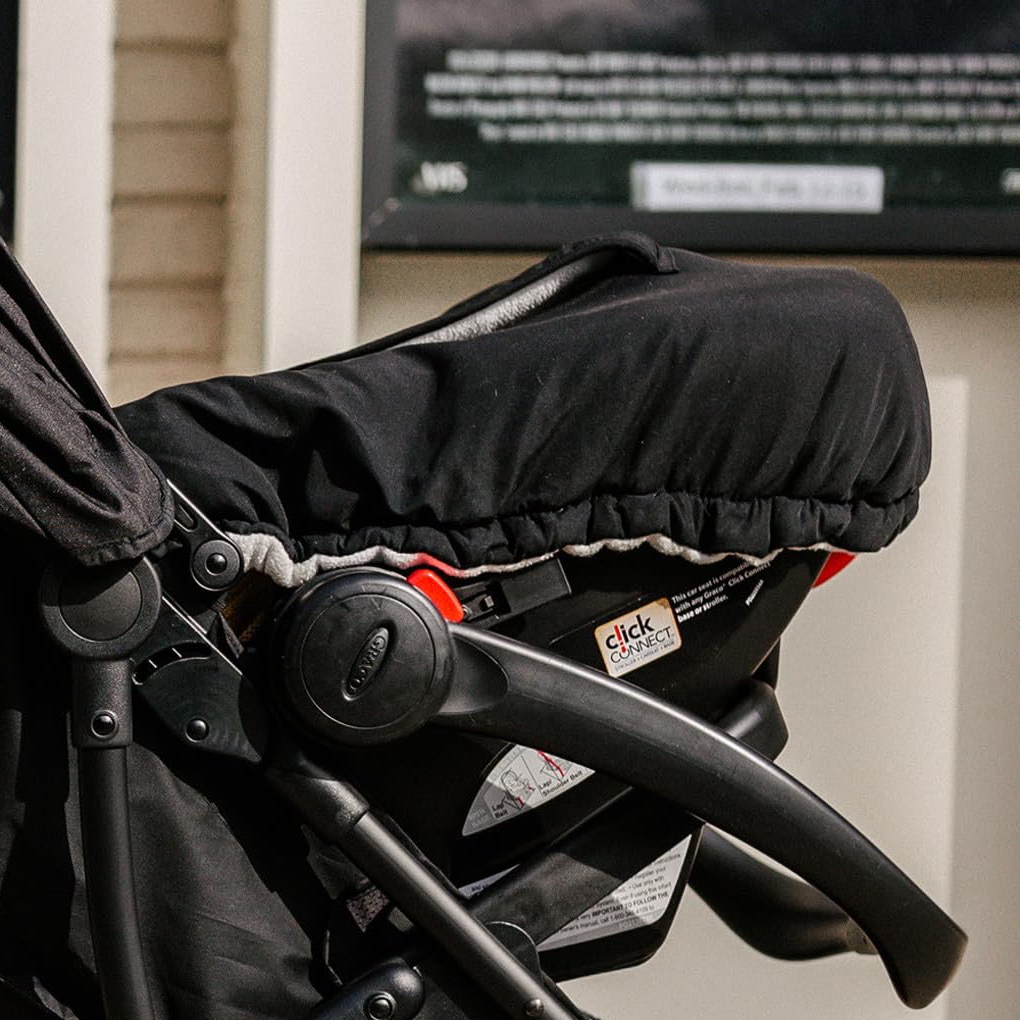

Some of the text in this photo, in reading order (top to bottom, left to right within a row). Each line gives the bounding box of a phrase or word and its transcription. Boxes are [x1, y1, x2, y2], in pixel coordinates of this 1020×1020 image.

[671, 561, 751, 604] This car seat is compatibl
[675, 600, 691, 613] with
[691, 595, 704, 606] any
[728, 575, 744, 587] Click
[677, 594, 729, 623] base or stroller.
[346, 635, 386, 696] GRACO
[591, 903, 623, 917] IMPORTANT
[633, 894, 657, 907] FOLLOW
